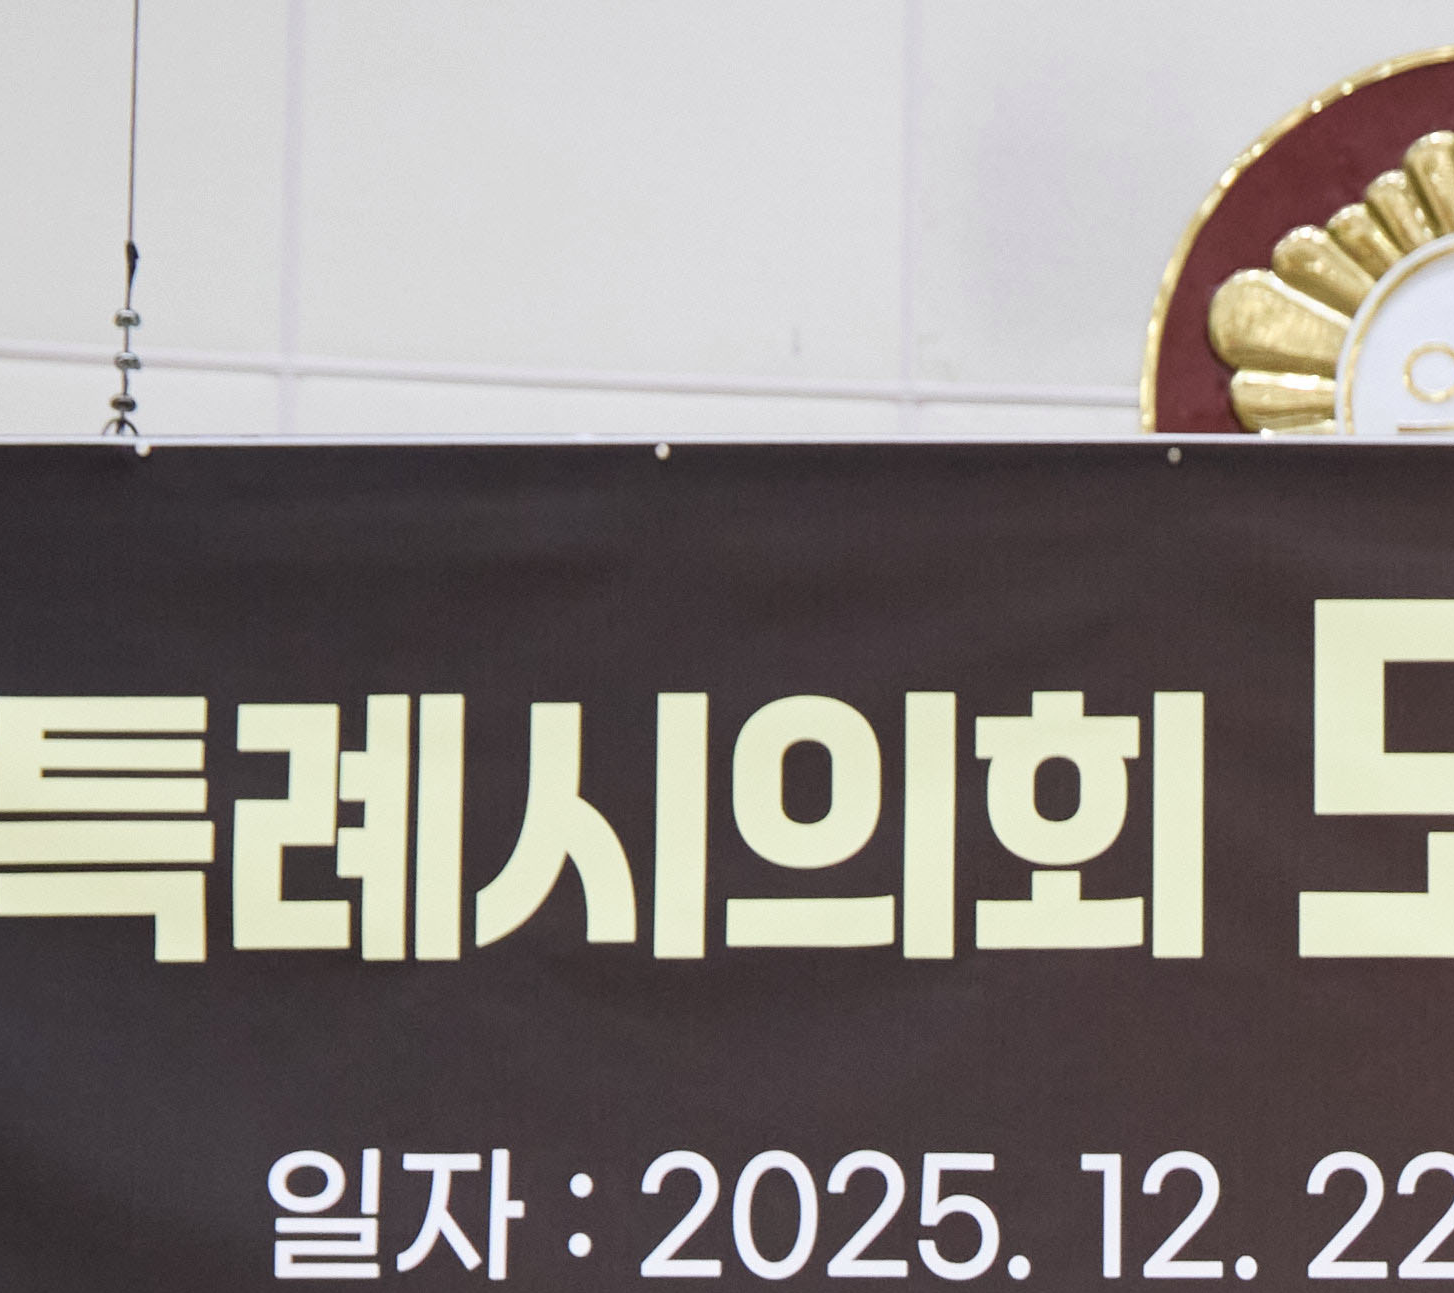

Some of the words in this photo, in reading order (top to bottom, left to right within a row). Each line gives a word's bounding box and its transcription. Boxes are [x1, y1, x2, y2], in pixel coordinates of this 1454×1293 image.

[267, 1147, 526, 1281] 일자
[568, 1172, 594, 1258] :
[640, 1149, 1032, 1281] 2025.
[1080, 1150, 1258, 1281] 12.
